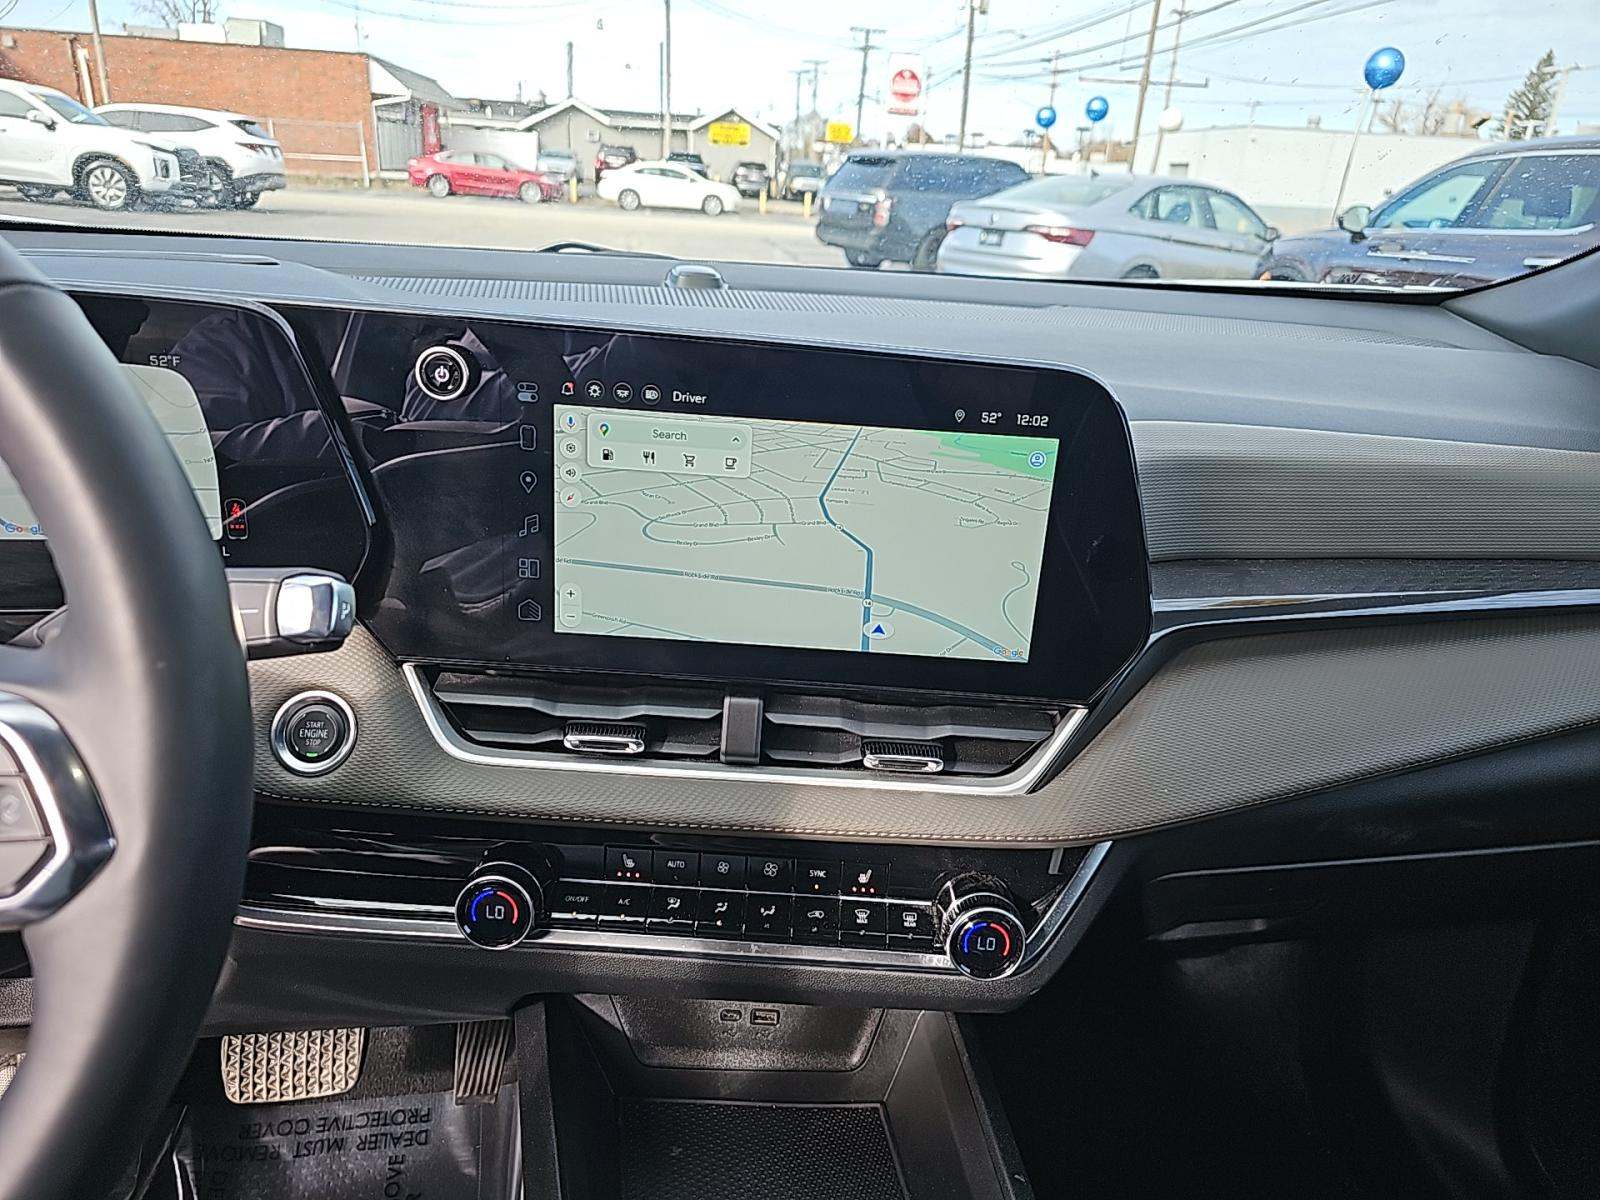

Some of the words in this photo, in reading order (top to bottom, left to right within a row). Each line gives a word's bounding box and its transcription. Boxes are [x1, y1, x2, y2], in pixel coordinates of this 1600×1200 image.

[672, 390, 707, 404] Driver
[980, 411, 1002, 424] 52°
[1016, 413, 1049, 427] 12:02
[652, 429, 687, 441] Search
[299, 728, 329, 739] ENGINE
[305, 738, 321, 746] STOP
[667, 860, 685, 869] AUTO
[809, 869, 826, 878] SYNC
[564, 895, 590, 903] ON/OFF
[618, 898, 631, 906] A/C
[486, 905, 505, 920] LO
[977, 937, 996, 951] LO
[315, 1106, 432, 1132] PROTECTIVE
[239, 1120, 310, 1140] COVER
[356, 1128, 430, 1150] DEALER
[293, 1137, 345, 1159] MUST
